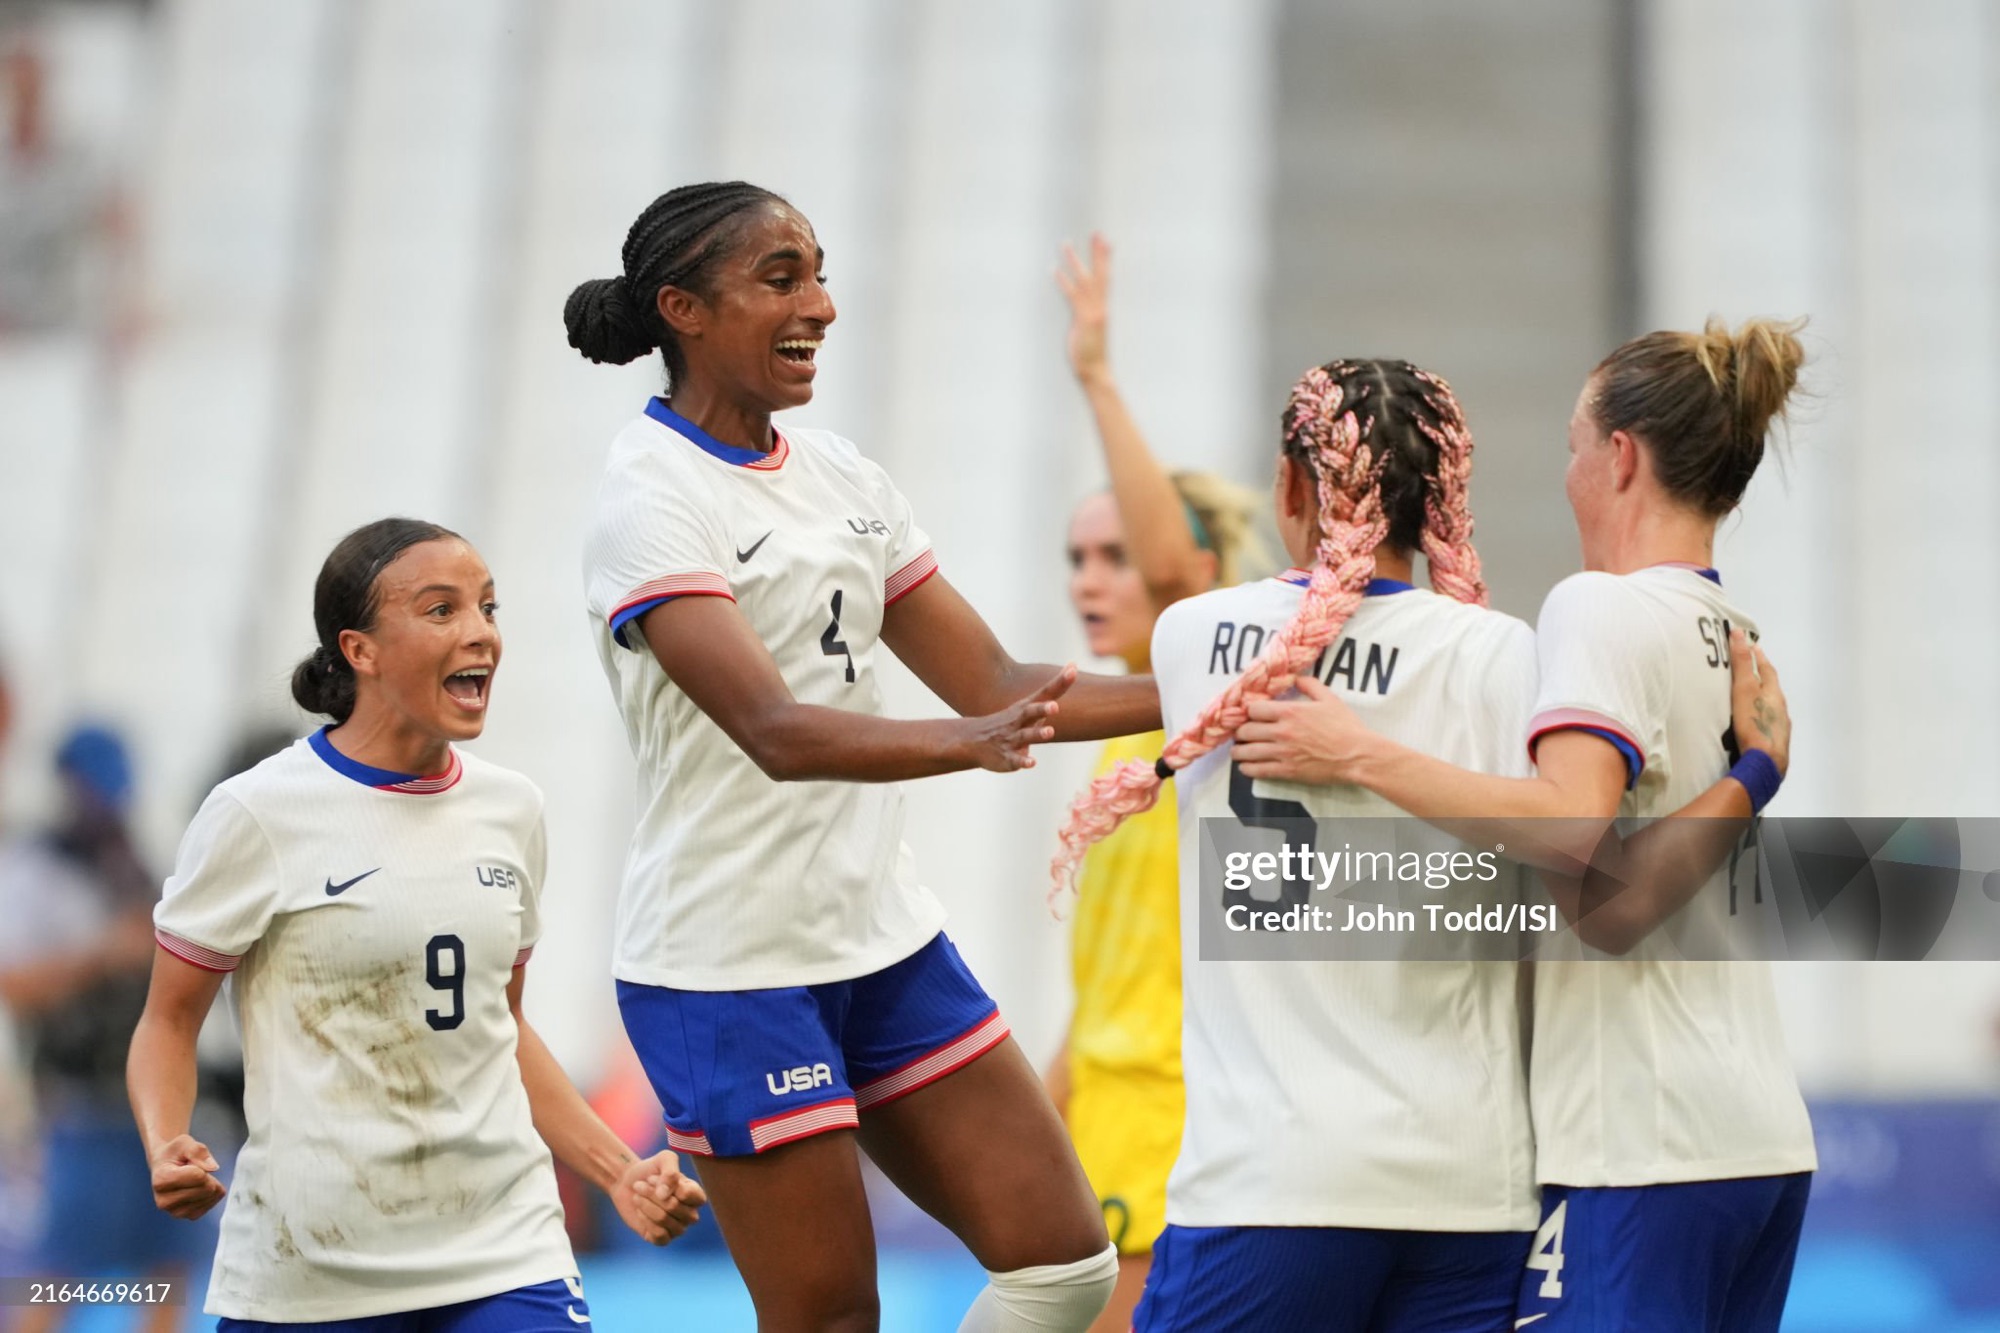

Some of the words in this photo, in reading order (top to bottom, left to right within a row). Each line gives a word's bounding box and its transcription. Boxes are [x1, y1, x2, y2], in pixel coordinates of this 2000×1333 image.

[820, 589, 855, 683] 4
[1208, 621, 1400, 695] ROAN
[476, 866, 517, 892] USA
[425, 934, 466, 1031] 9
[766, 1062, 833, 1096] USA
